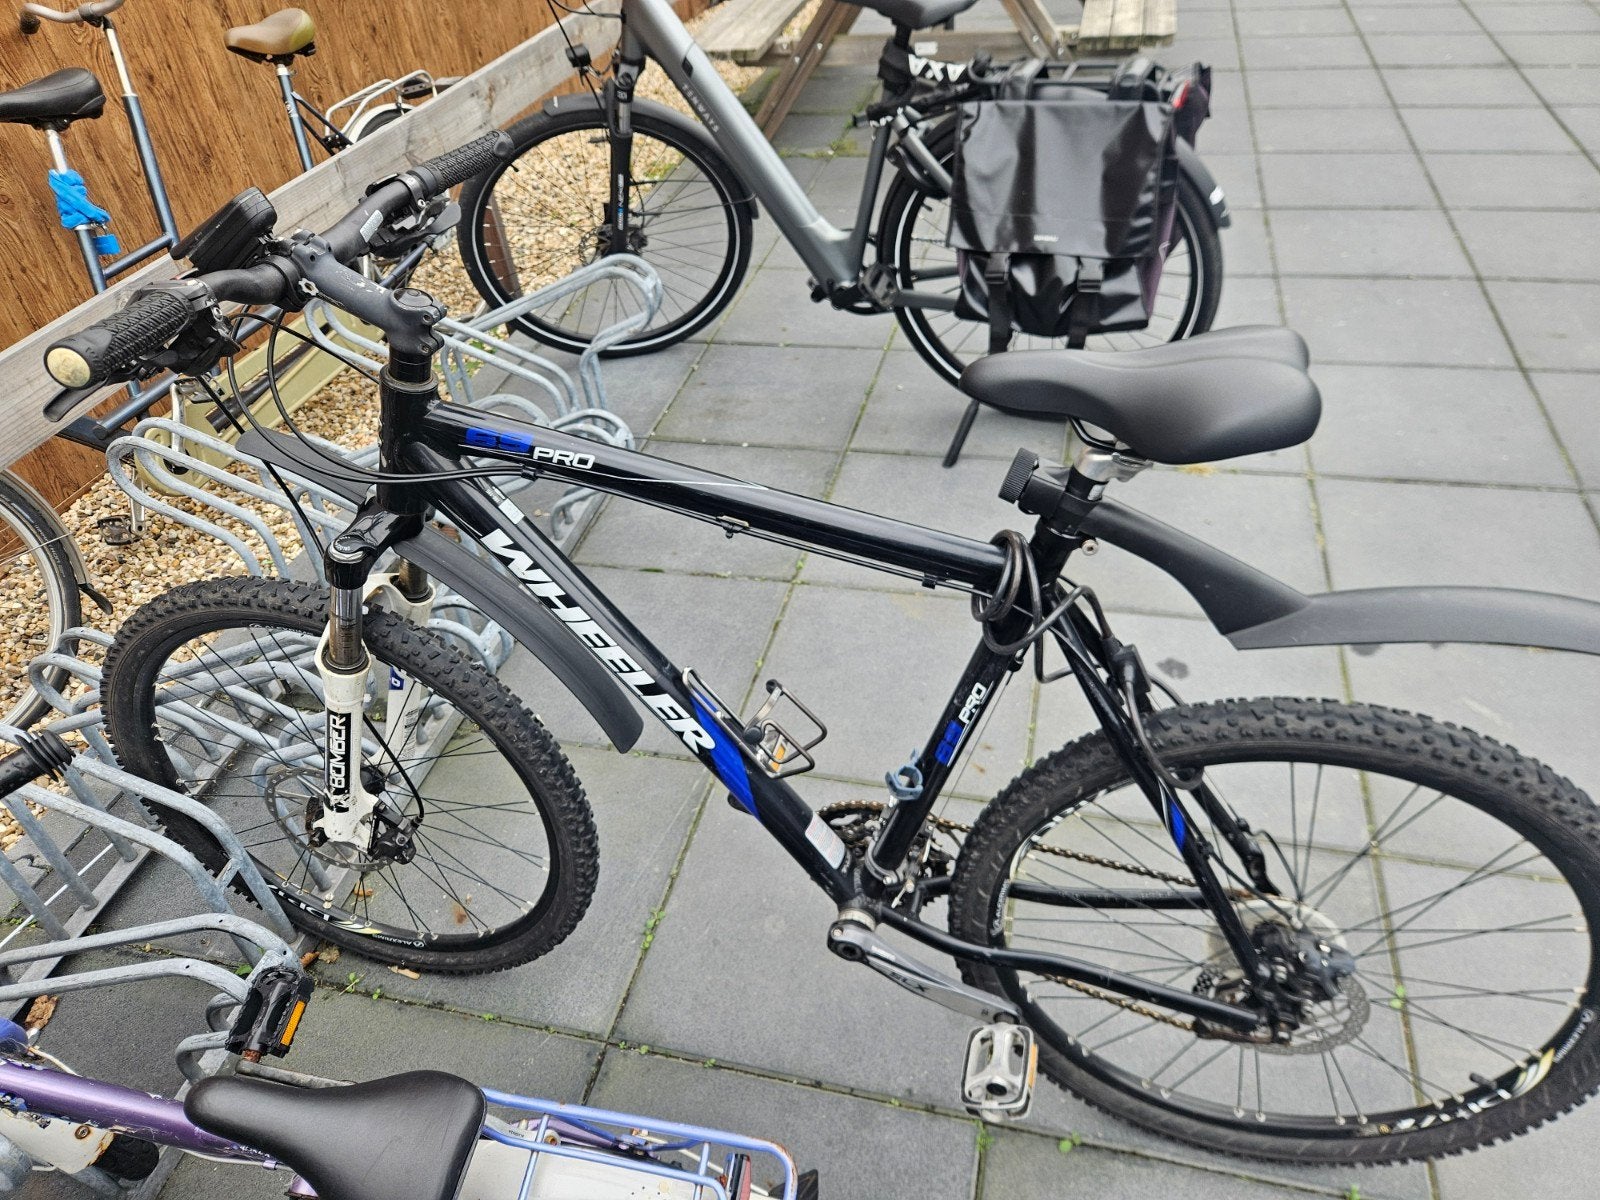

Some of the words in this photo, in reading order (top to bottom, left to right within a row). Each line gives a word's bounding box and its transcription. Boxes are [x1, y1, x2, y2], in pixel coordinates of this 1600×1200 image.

[908, 53, 967, 82] AXA
[682, 84, 719, 132] TENWAYS
[532, 446, 596, 469] PRO
[480, 528, 716, 754] WHEELER
[958, 682, 987, 724] PRO
[329, 713, 347, 789] BOMBER
